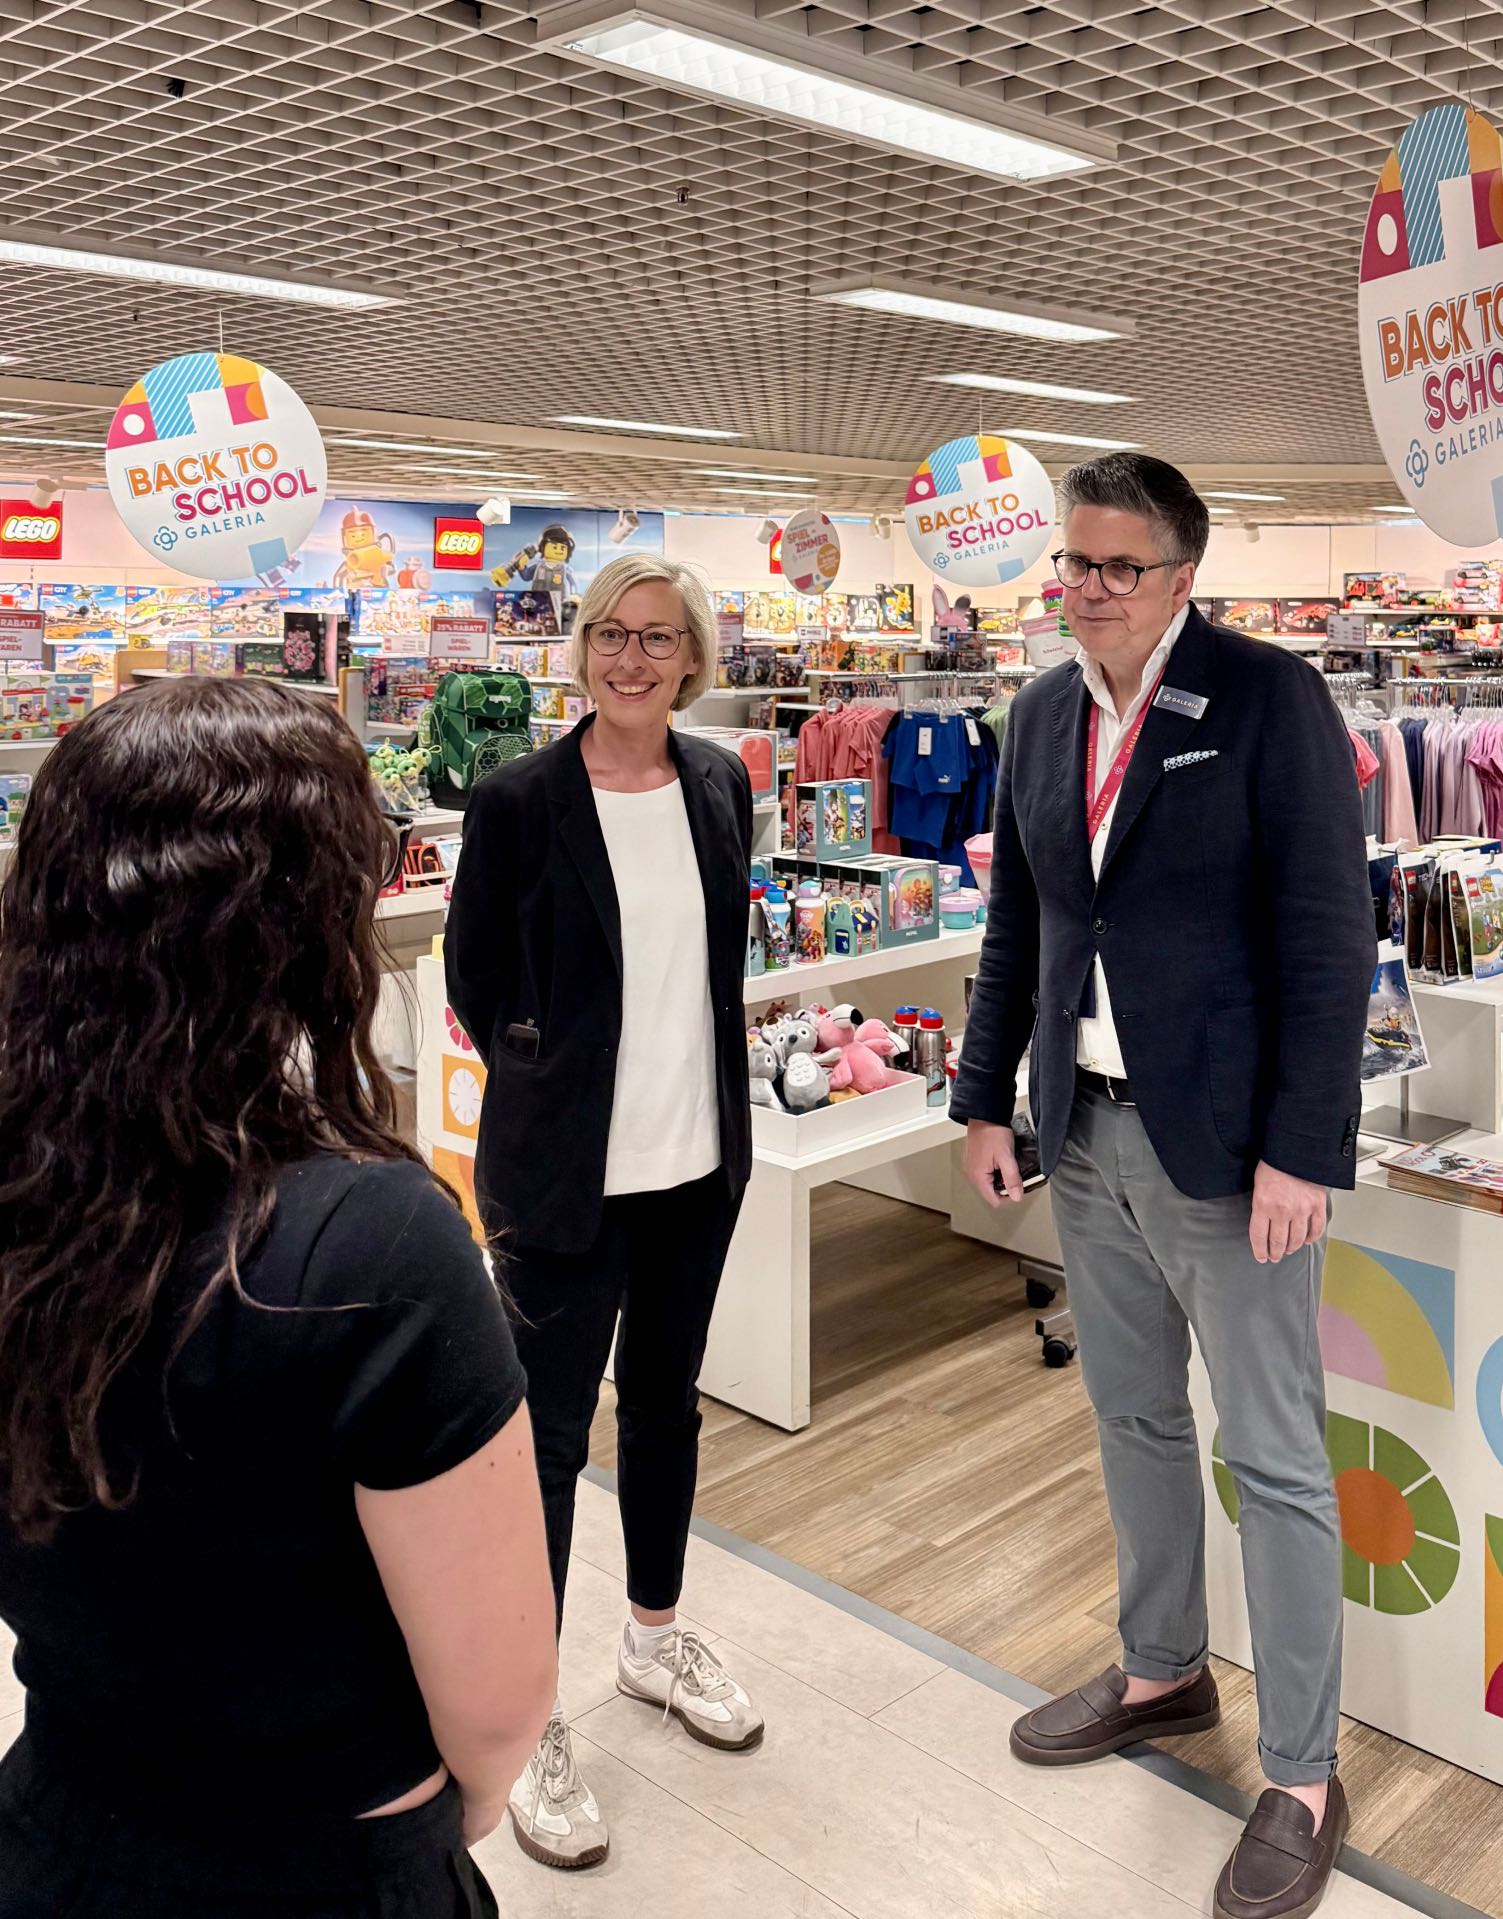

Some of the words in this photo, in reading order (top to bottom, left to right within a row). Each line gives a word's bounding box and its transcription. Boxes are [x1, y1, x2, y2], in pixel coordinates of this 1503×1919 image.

[1379, 297, 1473, 381] BACK
[1435, 417, 1503, 465] GALERIA
[126, 450, 227, 498] BACK
[230, 442, 279, 476] TO
[173, 468, 318, 522] SCHOOL
[185, 511, 266, 540] GALERIA
[917, 501, 983, 534] BACK
[986, 493, 1020, 516] TO
[3, 516, 59, 541] LEGO
[947, 508, 1049, 549] SCHOOL
[438, 532, 481, 555] LEGO
[795, 534, 829, 554] ZIMMER
[953, 540, 1010, 561] GALERIA
[1, 619, 38, 628] RABATT
[453, 624, 484, 632] RABATT
[1172, 697, 1199, 710] GALERIA
[1093, 794, 1110, 825] GALERIA
